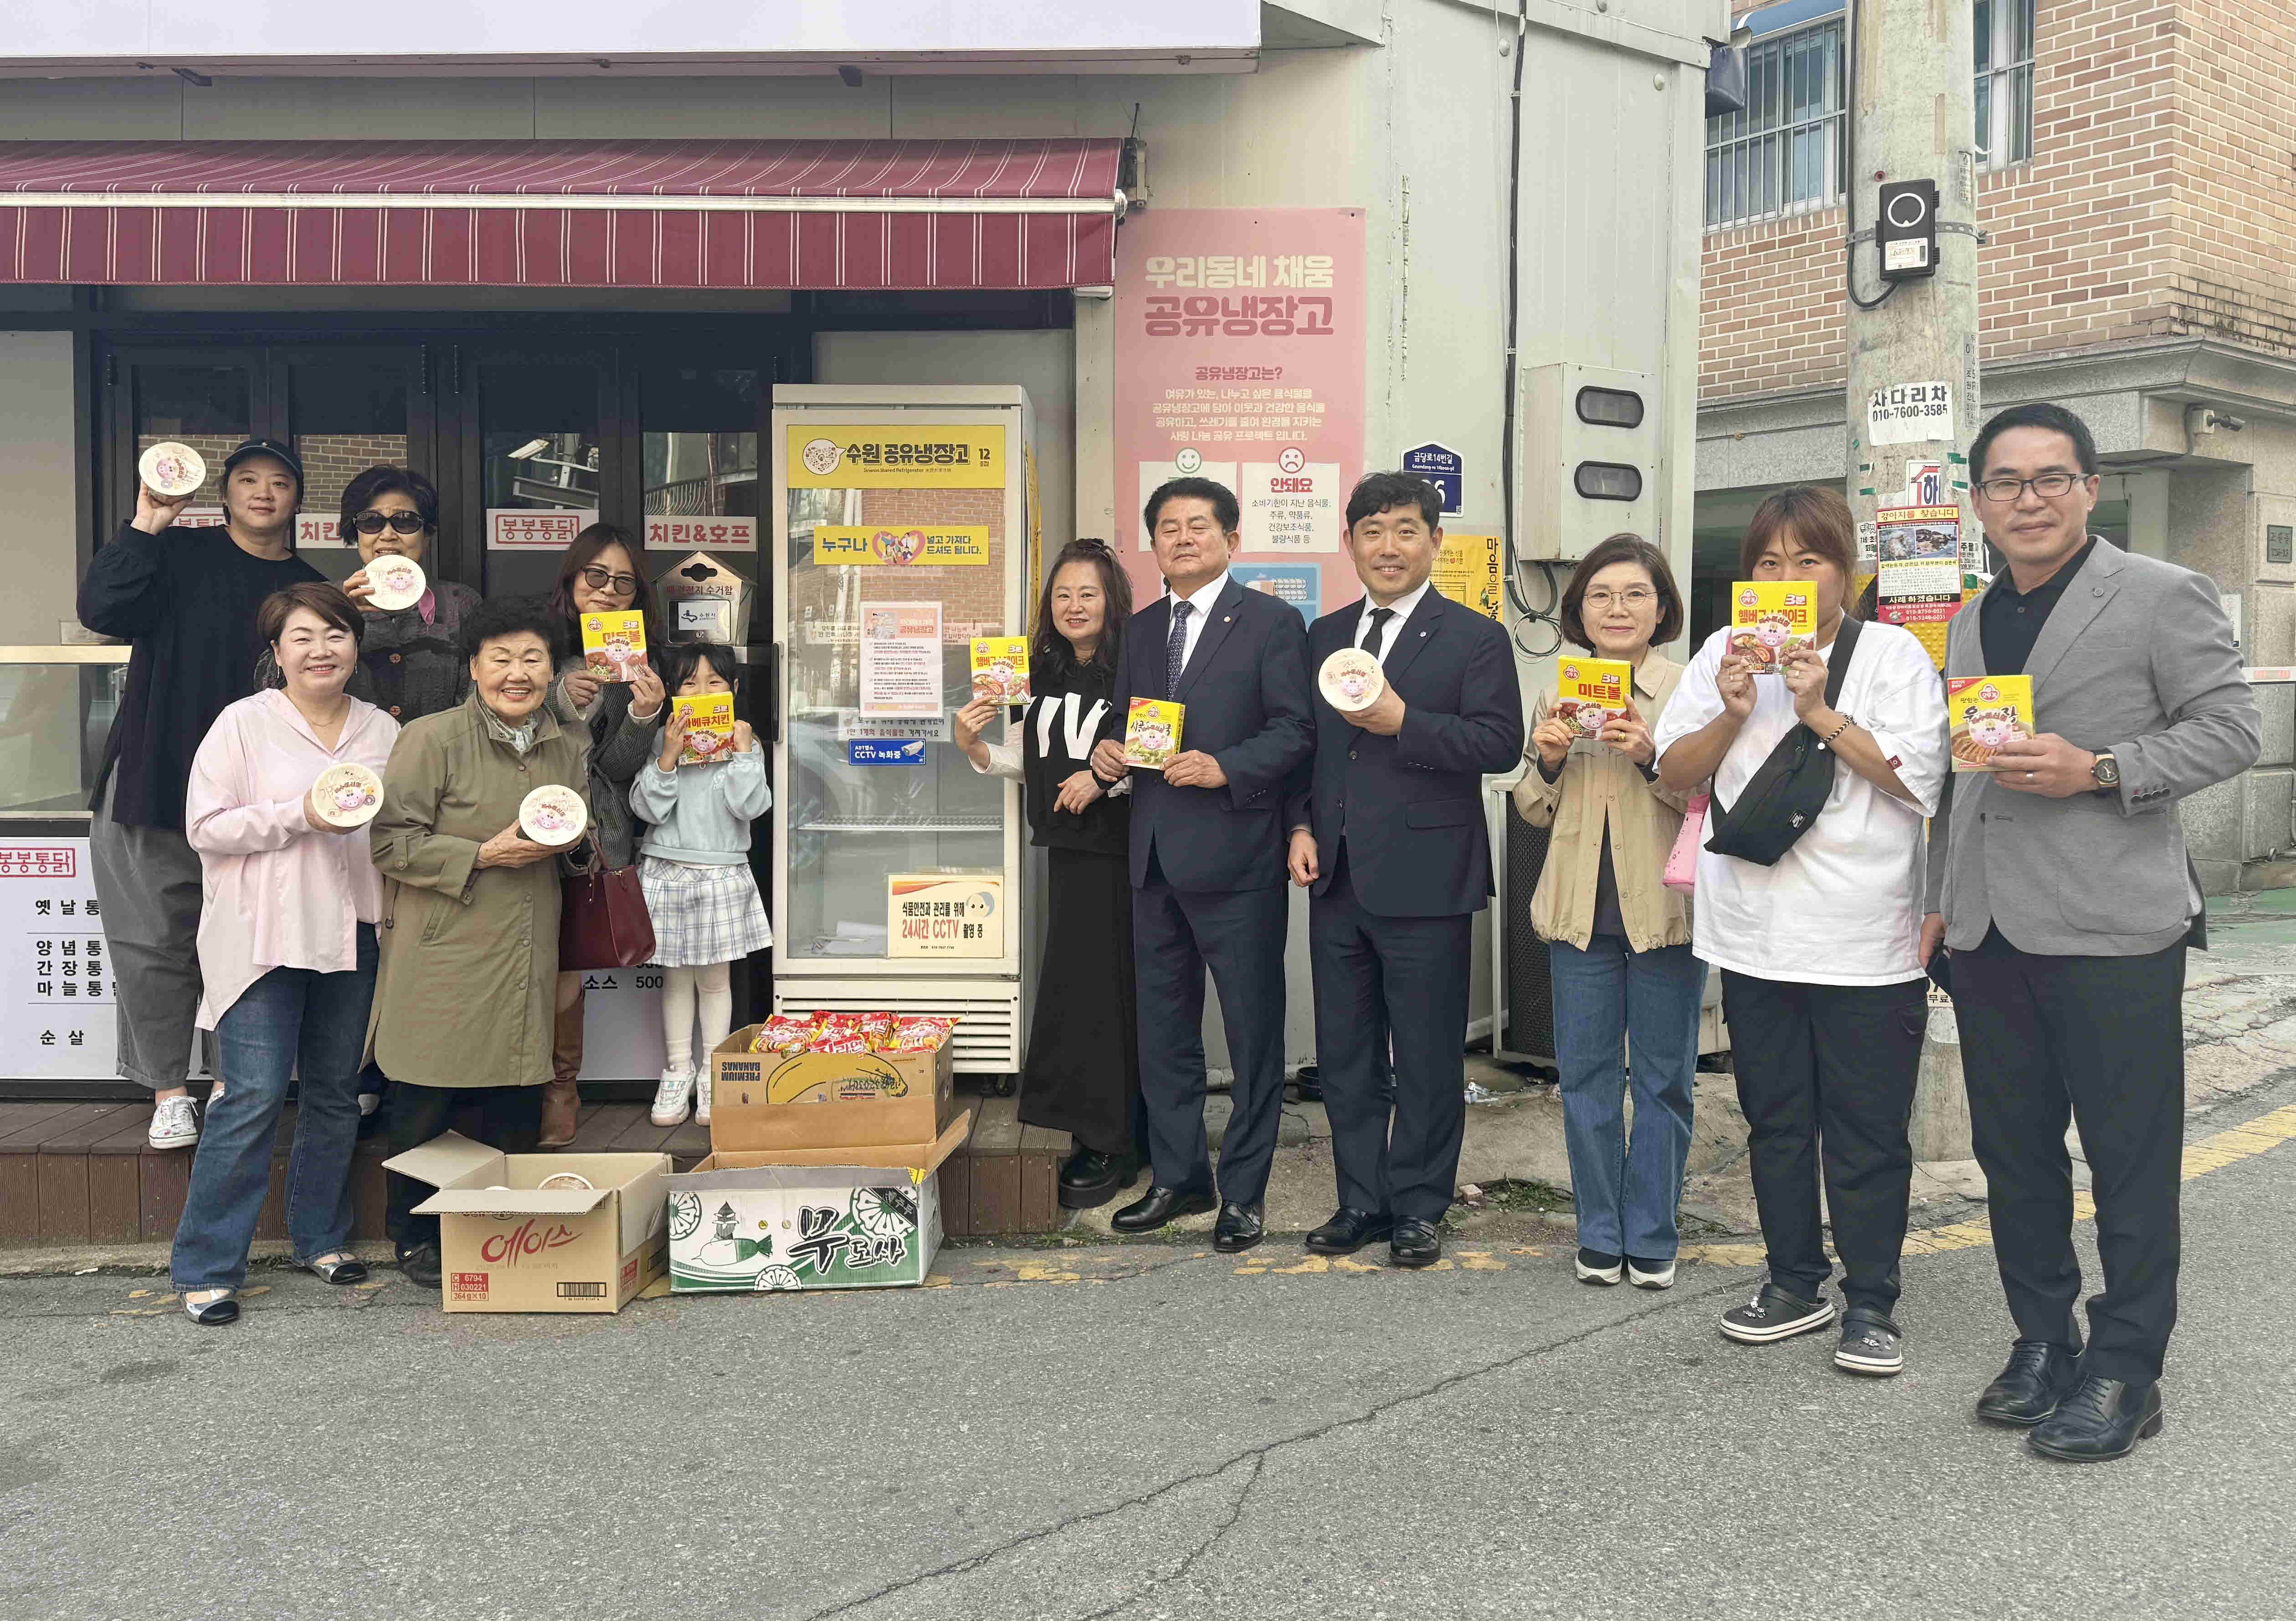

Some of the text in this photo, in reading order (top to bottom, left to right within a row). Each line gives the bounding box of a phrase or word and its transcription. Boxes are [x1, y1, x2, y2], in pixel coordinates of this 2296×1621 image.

[1145, 255, 1334, 288] 우리동네 채움
[1144, 295, 1334, 337] 공유냉장고
[1195, 366, 1283, 381] 공유냉장고는?
[1166, 389, 1195, 400] 여유가
[1221, 389, 1251, 400] 나누고
[1873, 385, 1947, 407] 사다리차
[1234, 403, 1263, 413] 이웃과
[1873, 404, 1947, 422] 010-7600-3585
[1292, 417, 1322, 427] 지키는
[1213, 431, 1232, 442] 공유
[1235, 431, 1274, 441] 프로젝트
[1276, 431, 1308, 442] 입니다.
[846, 443, 991, 464] 수원 공유냉장고 12
[1414, 452, 1453, 464] 금당로14번길
[1270, 477, 1313, 493] 안돼요
[1251, 499, 1288, 508] 소비기한이
[1290, 499, 1305, 508] 지난
[1269, 511, 1313, 520] 주류, 약품류,
[1881, 509, 1954, 521] 강아지를 찾습니다
[501, 518, 575, 541] 봉봉통닭
[1269, 523, 1314, 532] 건강보조식품,
[649, 524, 750, 544] 치킨&호프
[945, 535, 971, 544] 가져다
[1303, 535, 1310, 543] 등
[822, 537, 868, 552] 누구나
[926, 545, 982, 555] 드셔도 됩니다.
[706, 585, 733, 596] 수거함
[1908, 594, 1951, 603] 하겠습니다
[1578, 684, 1621, 700] 미트볼
[878, 751, 901, 759] 녹화중
[0, 852, 70, 874] 봉봉통닭
[902, 901, 965, 917] 식품안전과 관리를 위해
[902, 918, 983, 939] 24시간 CCTV 촬영 중
[584, 975, 618, 989] 소스
[1928, 994, 1953, 1003] 무료
[721, 1062, 760, 1071] BANANAS
[721, 1072, 760, 1081] PREMIUM
[786, 1206, 906, 1275] 무도사
